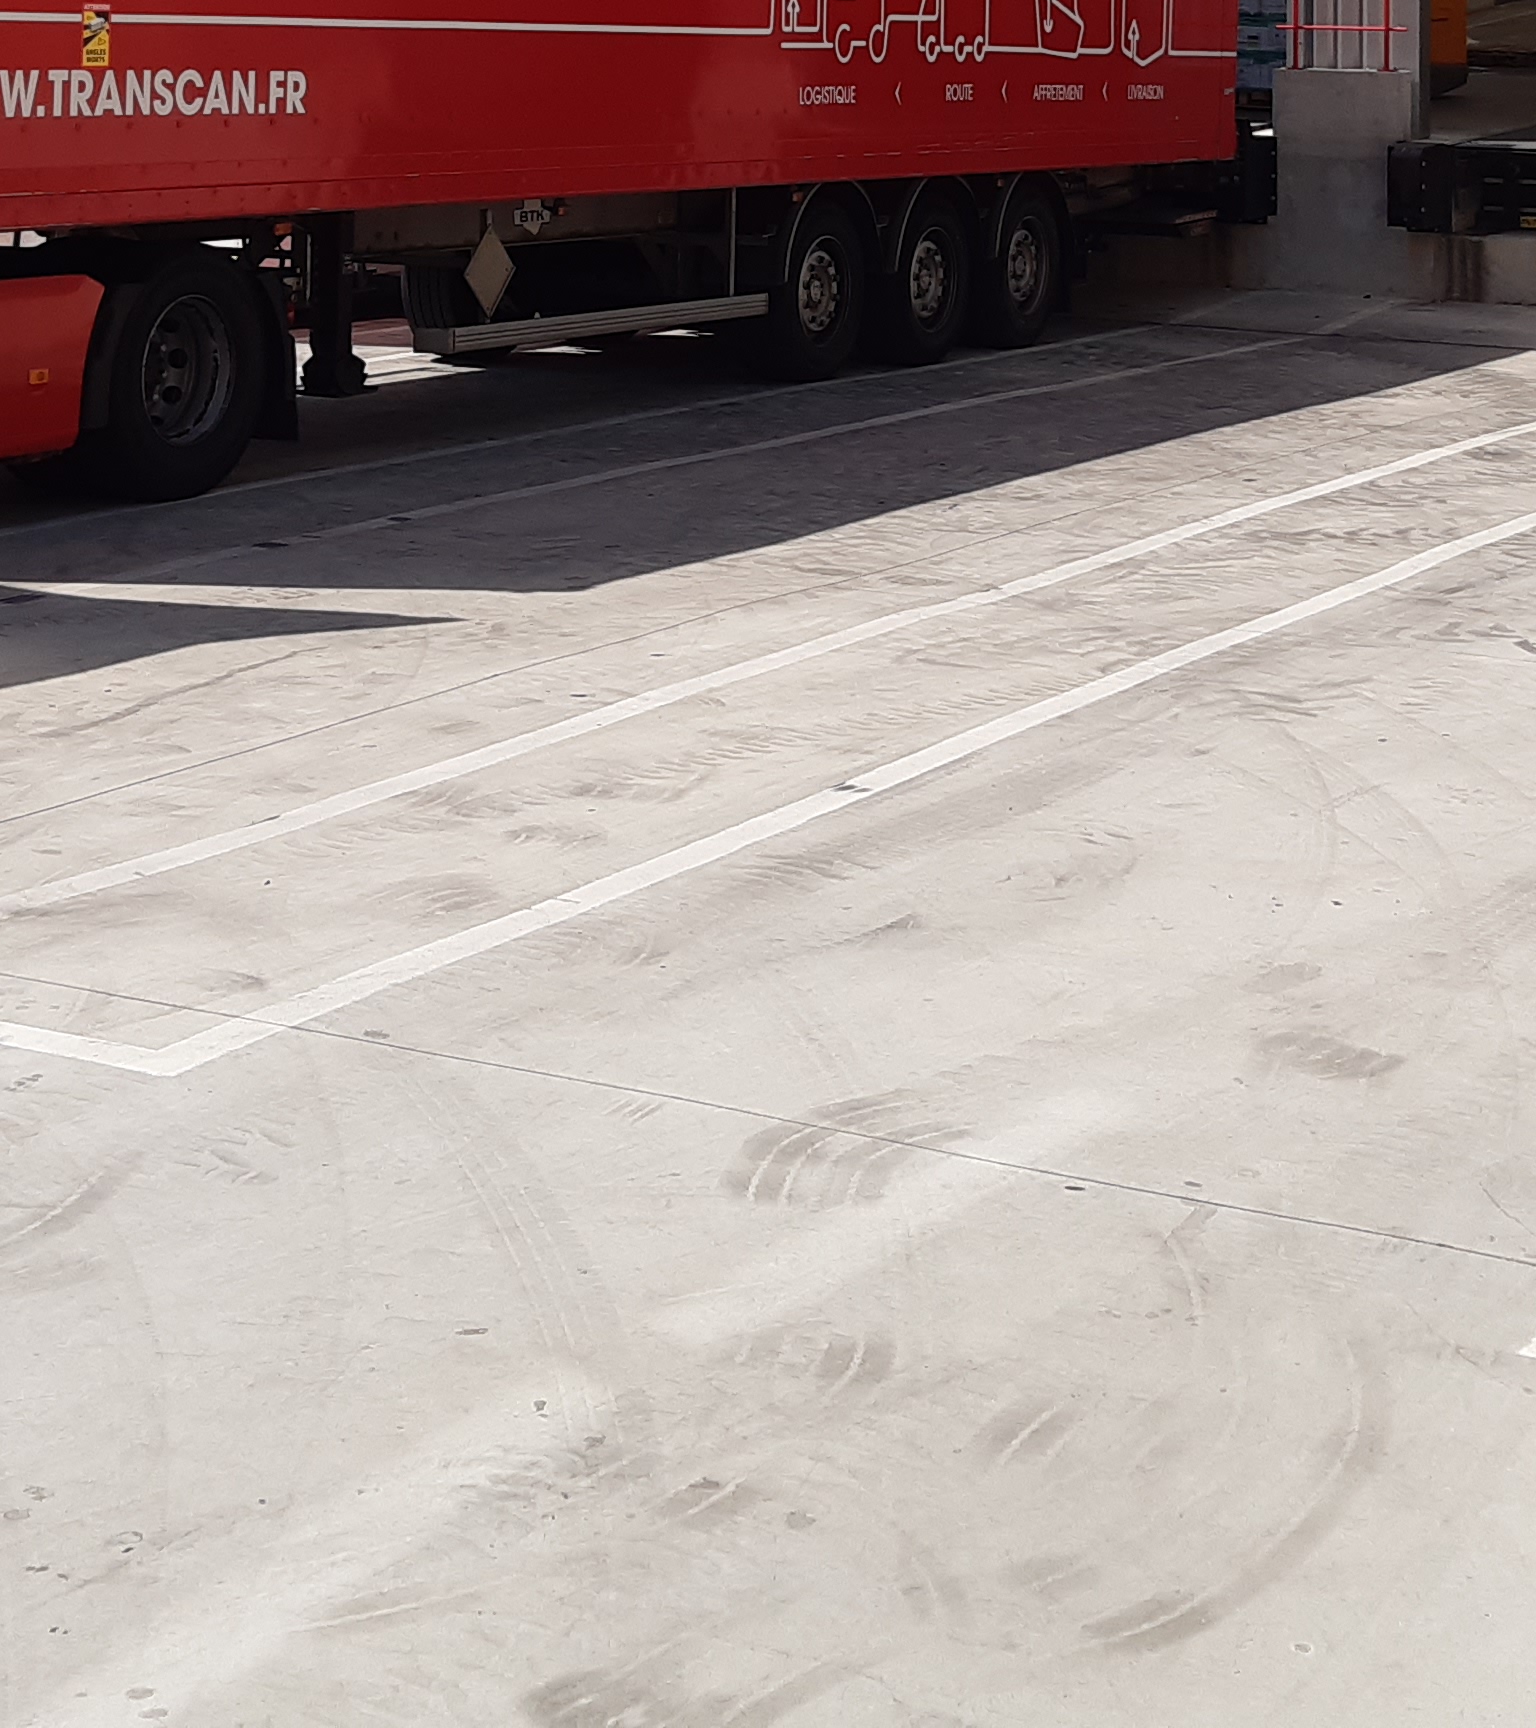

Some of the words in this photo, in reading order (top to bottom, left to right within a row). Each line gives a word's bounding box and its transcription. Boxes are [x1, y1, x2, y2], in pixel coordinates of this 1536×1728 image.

[799, 85, 856, 105] LOGISTIQUE
[945, 83, 974, 101] ROUTE
[1127, 84, 1164, 100] LIVRAISON
[520, 210, 544, 223] BTK
